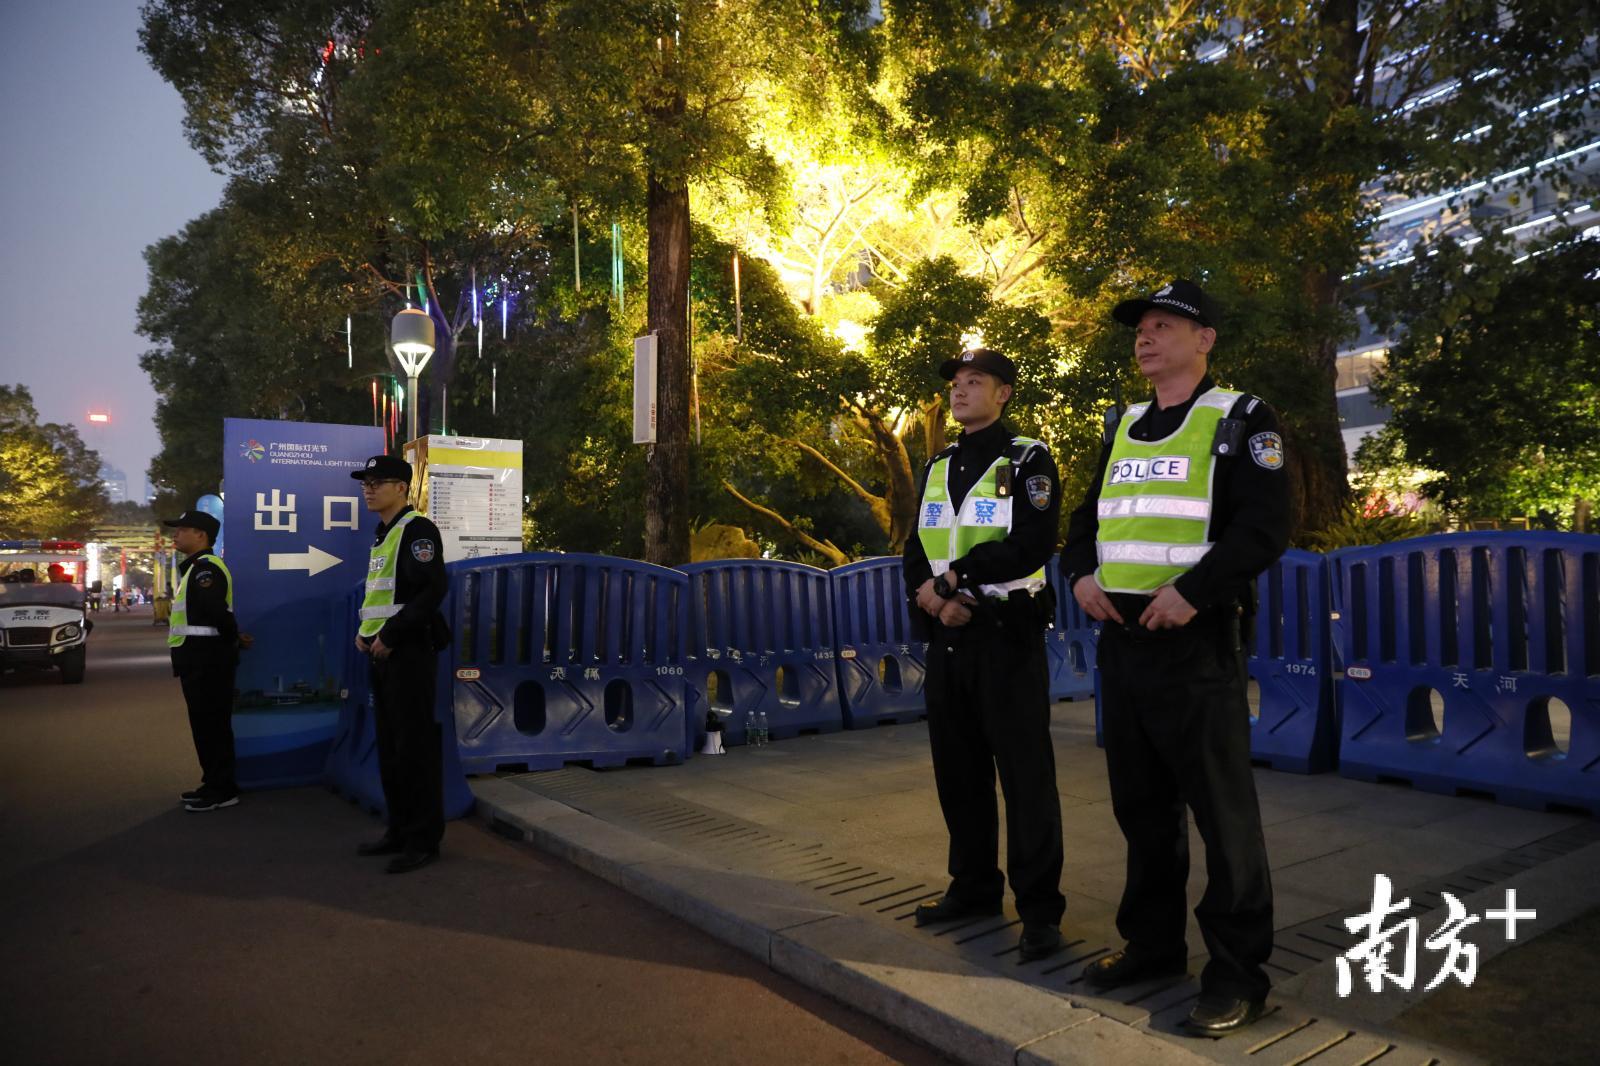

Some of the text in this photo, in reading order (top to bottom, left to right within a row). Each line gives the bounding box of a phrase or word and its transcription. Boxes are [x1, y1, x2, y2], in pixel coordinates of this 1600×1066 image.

[270, 443, 328, 453] 广州国际灯光节
[272, 458, 322, 466] INTERNATIONAL
[254, 489, 359, 533] 出口
[925, 499, 997, 526] 警察
[655, 666, 684, 676] 1060
[1285, 663, 1316, 676] 1974
[1452, 672, 1518, 693] 天河
